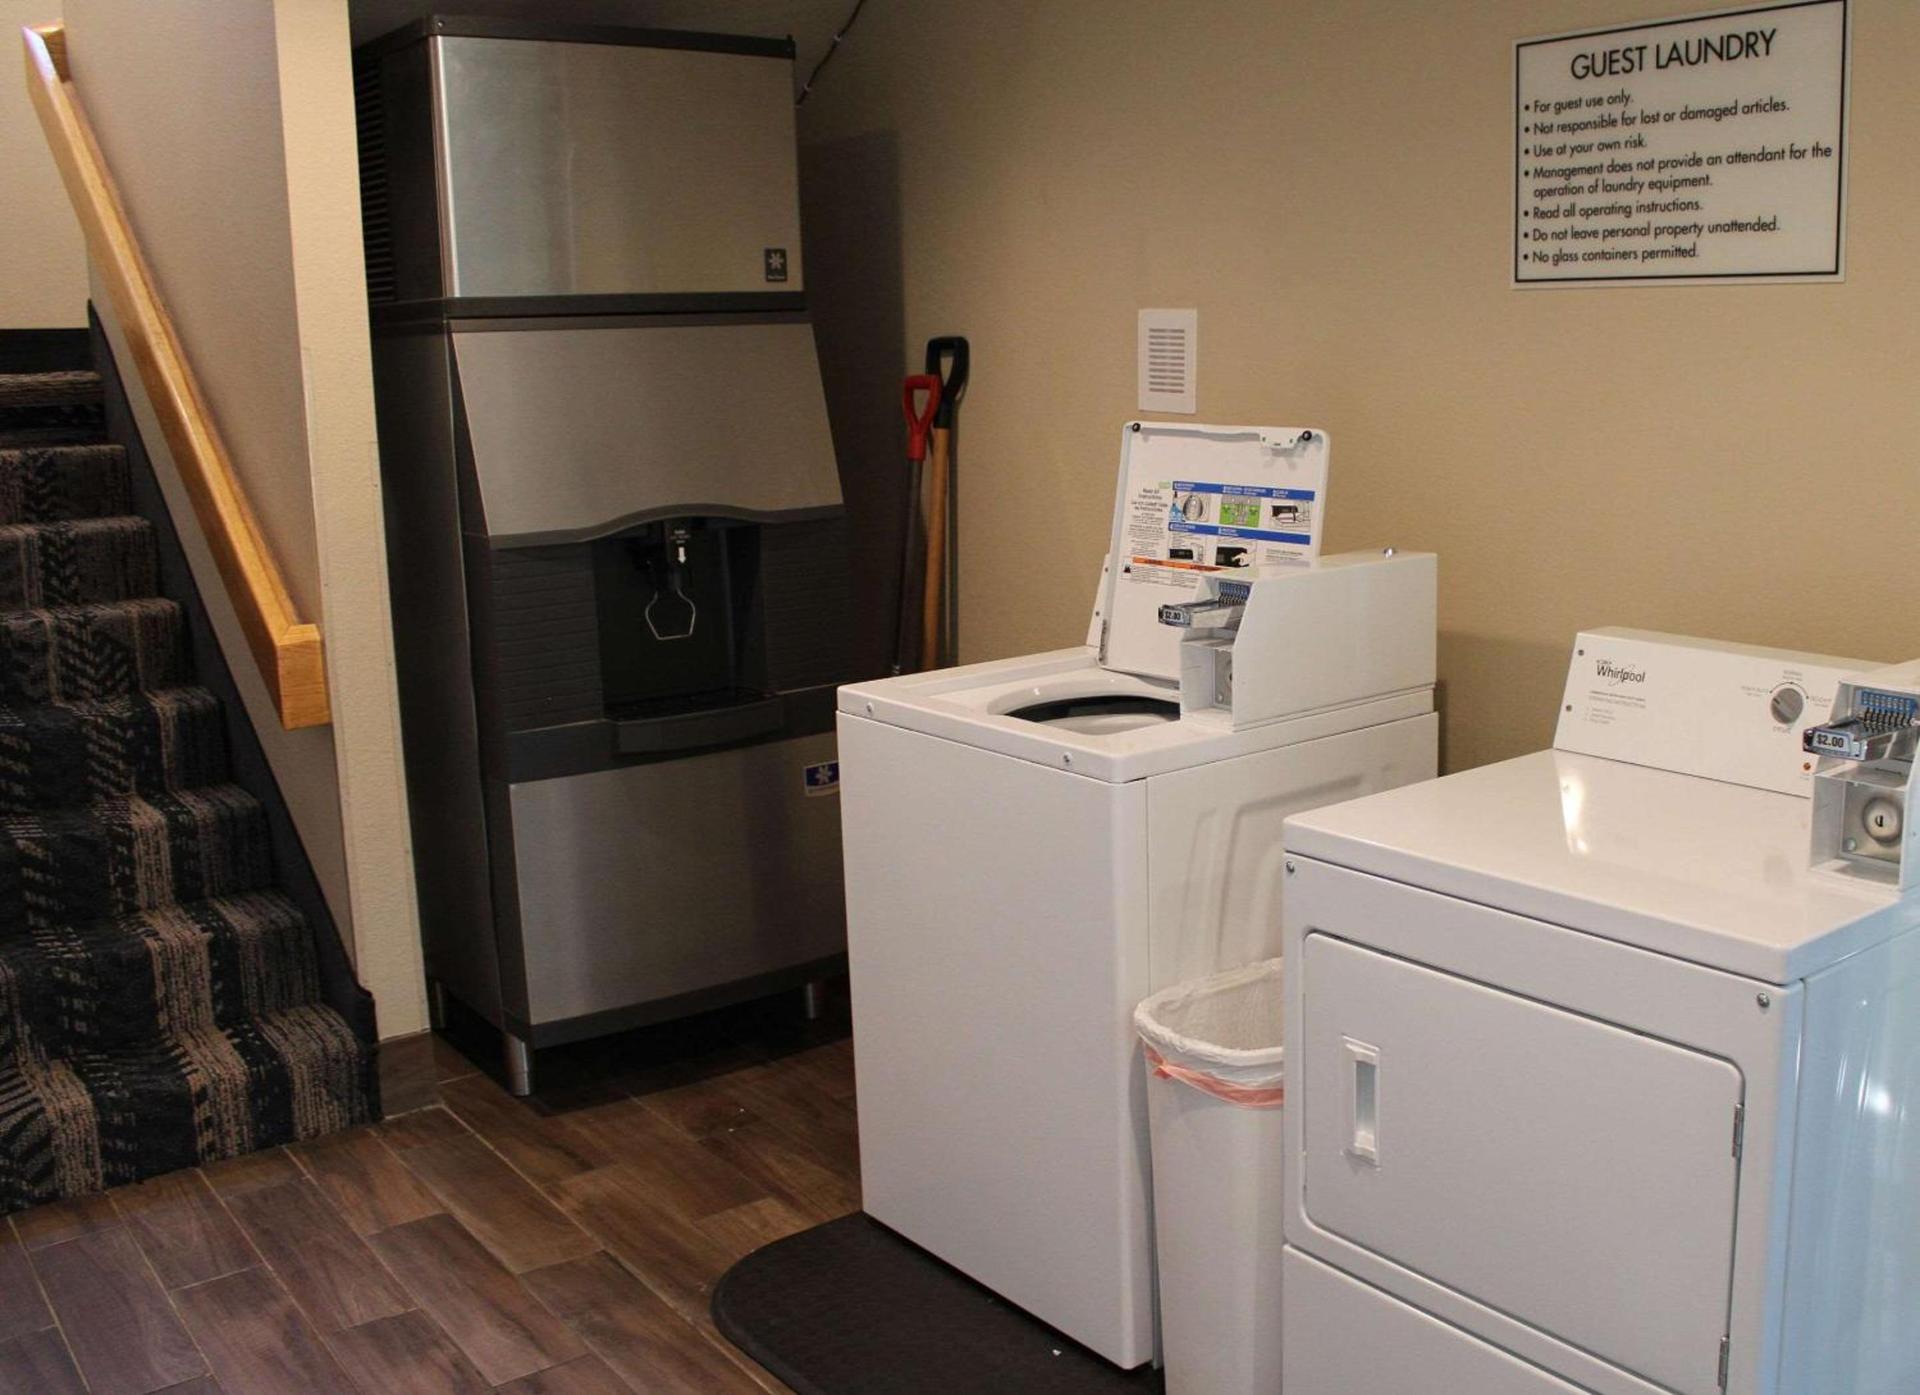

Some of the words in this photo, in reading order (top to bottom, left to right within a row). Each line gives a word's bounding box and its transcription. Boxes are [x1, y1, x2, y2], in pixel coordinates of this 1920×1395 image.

[1571, 46, 1647, 79] GUEST
[1656, 28, 1776, 69] LAUNDRY
[1534, 100, 1550, 113] For
[1554, 97, 1582, 115] guest
[1585, 96, 1603, 107] use
[1607, 88, 1634, 107] only.
[1534, 122, 1554, 135] Not
[1557, 114, 1617, 135] responsible
[1621, 111, 1636, 126] for
[1640, 109, 1660, 124] lost
[1663, 112, 1676, 122] or
[1680, 99, 1738, 122] damaged
[1742, 95, 1790, 115] articles.
[1533, 145, 1553, 157] Use
[1556, 144, 1567, 155] at
[1570, 143, 1593, 158] your
[1597, 141, 1620, 152] own
[1624, 133, 1647, 149] risk.
[1533, 163, 1603, 180] Management
[1607, 158, 1632, 173] does
[1636, 159, 1655, 171] not
[1658, 152, 1703, 173] provide
[1706, 155, 1722, 166] an
[1726, 145, 1785, 165] attendant
[1789, 142, 1807, 159] for
[1812, 141, 1832, 158] the
[1533, 184, 1584, 199] operation
[1588, 178, 1599, 194] of
[1602, 176, 1644, 195] laundry
[1648, 174, 1713, 192] equipment.
[1533, 204, 1559, 219] Read
[1563, 202, 1575, 217] all
[1579, 201, 1632, 220] operating
[1636, 198, 1703, 213] instructions.
[1533, 228, 1548, 241] Do
[1551, 229, 1568, 240] not
[1571, 225, 1599, 239] leave
[1602, 221, 1651, 242] personal
[1654, 222, 1704, 239] property
[1708, 215, 1780, 233] unattended.
[1532, 251, 1549, 262] No
[1552, 248, 1578, 266] glass
[1582, 247, 1638, 262] containers
[1596, 665, 1646, 683] Whirlpool
[1817, 733, 1844, 748] $2.00
